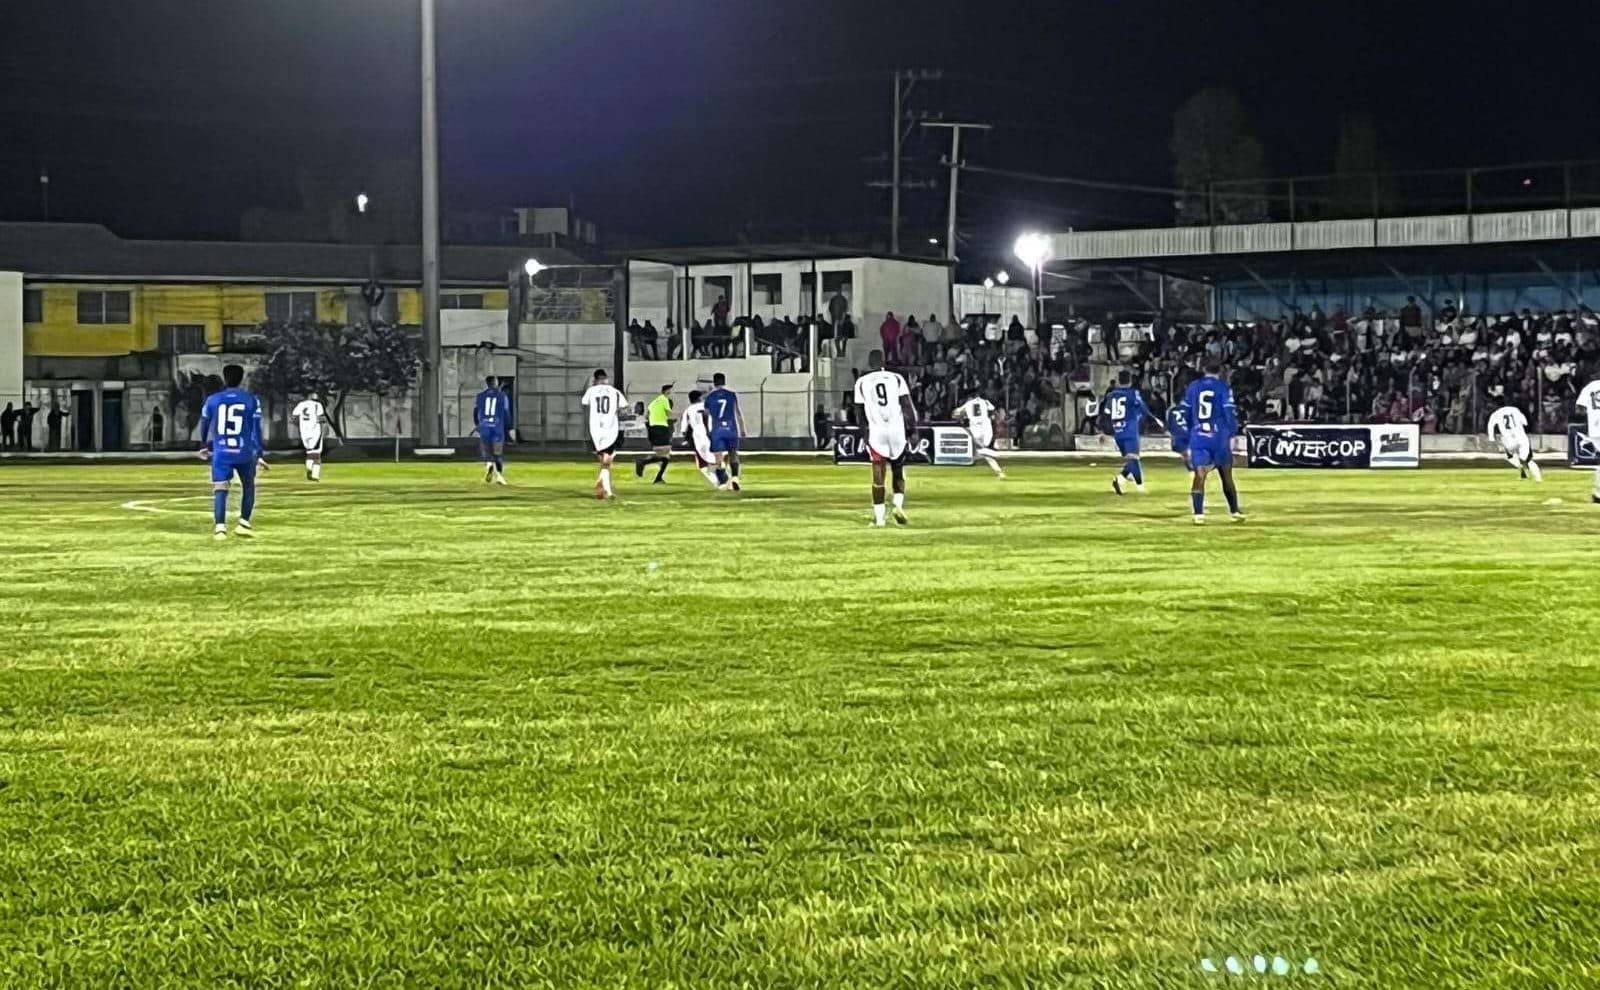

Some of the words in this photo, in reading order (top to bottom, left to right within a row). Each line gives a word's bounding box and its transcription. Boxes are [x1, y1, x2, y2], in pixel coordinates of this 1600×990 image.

[595, 395, 610, 414] 10
[875, 383, 888, 406] 9
[484, 397, 497, 416] 11
[717, 398, 727, 418] 7
[1198, 390, 1215, 420] 6
[217, 403, 246, 436] 15
[1503, 414, 1517, 430] 21
[1275, 438, 1367, 459] INTERCOP
